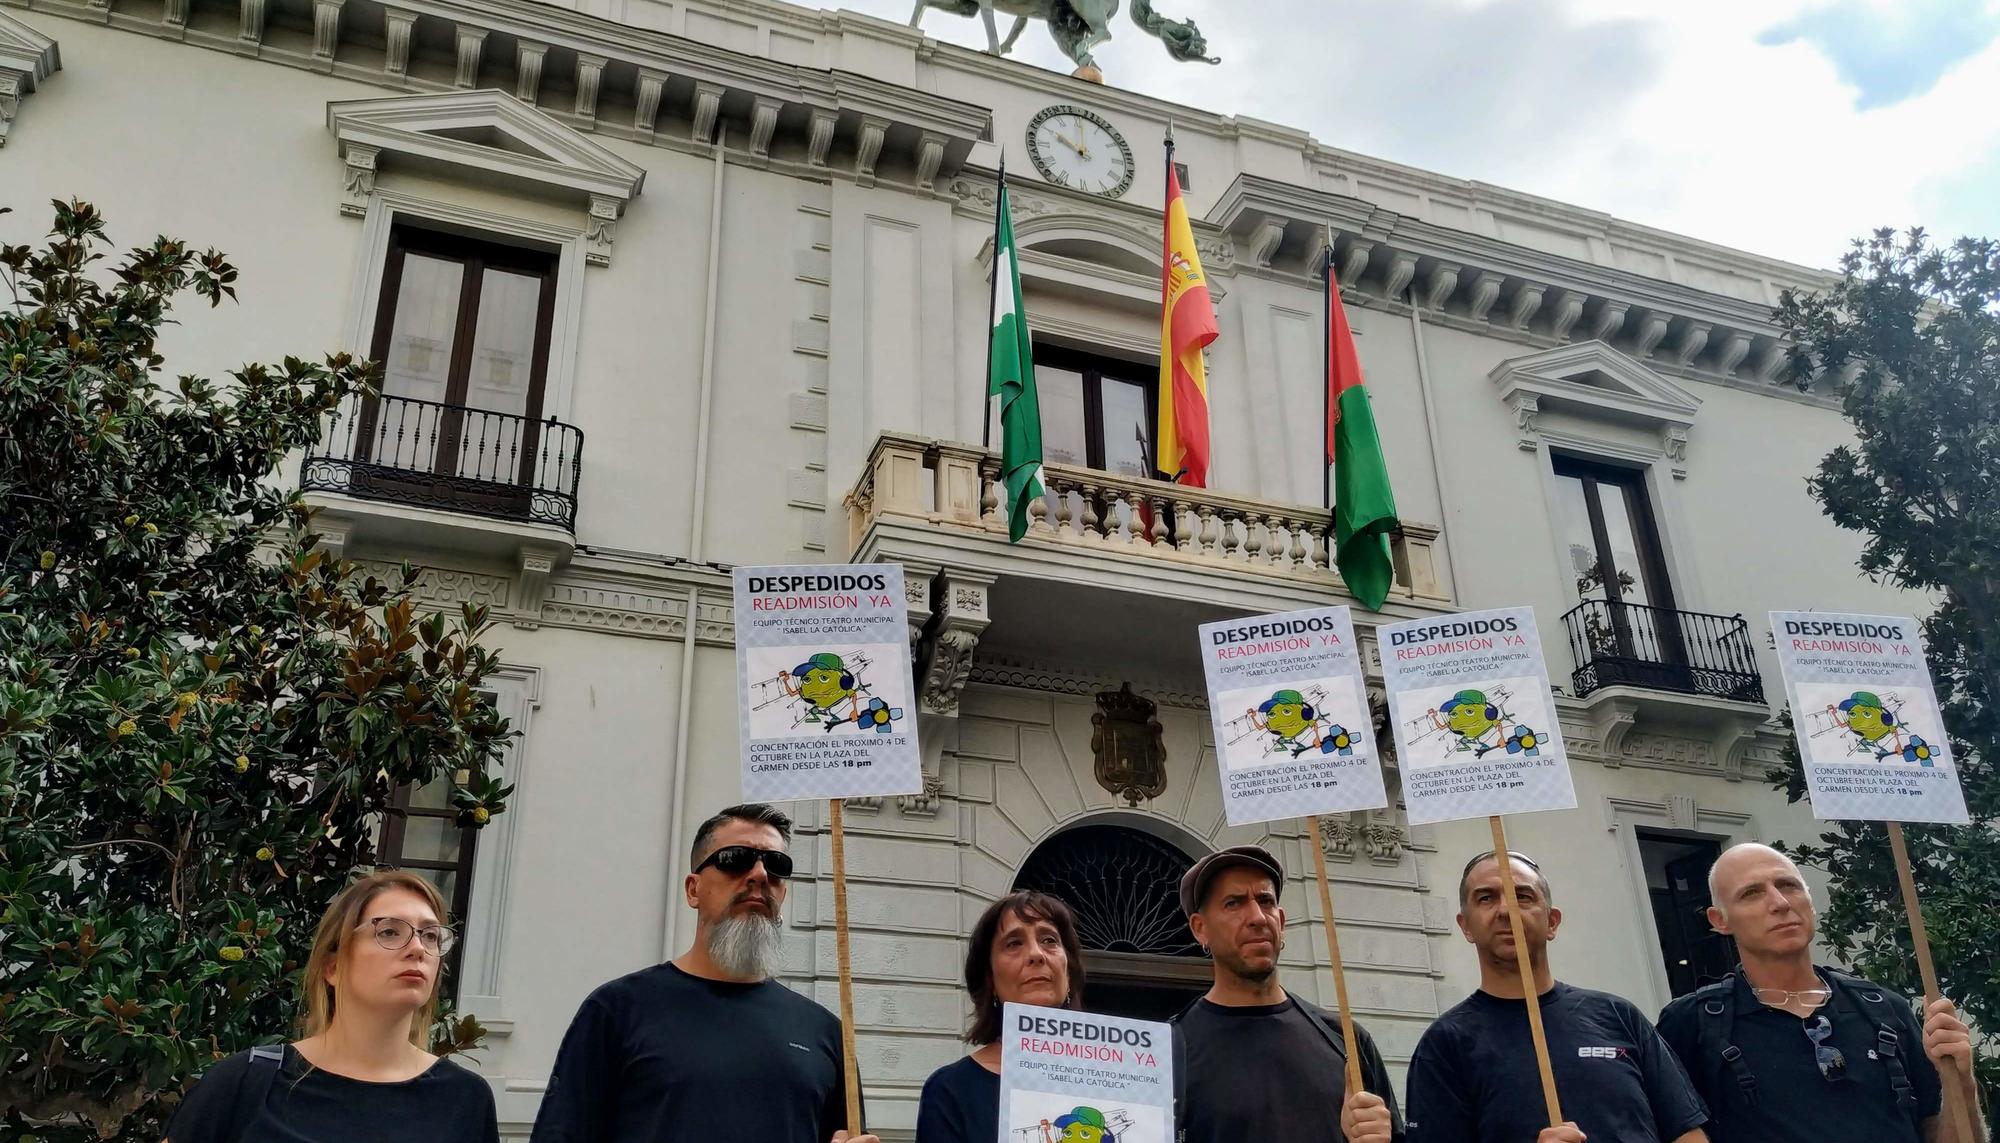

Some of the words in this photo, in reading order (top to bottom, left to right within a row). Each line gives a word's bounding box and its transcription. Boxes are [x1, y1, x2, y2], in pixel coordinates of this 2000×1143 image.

[749, 575, 885, 592] DESPEDIDOS
[754, 594, 858, 610] READMISIÓN
[869, 595, 891, 607] YA
[783, 626, 808, 634] ISABEL
[1213, 617, 1333, 645] DESPEDIDOS
[1391, 618, 1517, 646] DESPEDIDOS
[1785, 621, 1903, 640] DESPEDIDOS
[1218, 636, 1310, 660] READMISIÓN
[1320, 634, 1341, 646] YA
[1397, 637, 1493, 661] READMISIÓN
[1503, 635, 1525, 647] YA
[1792, 639, 1883, 654] READMISIÓN
[1890, 645, 1911, 655] YA
[1220, 665, 1245, 673] EQUIPO
[1247, 661, 1277, 670] TÉCNICO
[1308, 653, 1346, 662] MUNICIPAL
[1246, 669, 1268, 677] ISABEL
[1281, 664, 1316, 672] CATÓLICA
[1400, 666, 1425, 674] EQUIPO
[1428, 661, 1459, 669] TÉCNICO
[1461, 657, 1489, 665] TEATRO
[1492, 654, 1531, 662] MUNICIPAL
[1463, 664, 1499, 672] CATÓLICA
[1882, 662, 1917, 670] MUNICIPAL
[751, 741, 828, 752] CONCENTRACIÓN
[844, 739, 883, 747] PROXIMO
[751, 753, 792, 762] OCTUBRE
[751, 764, 789, 772] CARMEN
[792, 762, 820, 770] DESDE
[857, 760, 871, 768] pm
[1229, 767, 1296, 780] CONCENTRACIÓN
[1311, 761, 1346, 771] PROXIMO
[1410, 766, 1481, 780] CONCENTRACIÓN
[1496, 761, 1533, 770] PROXIMO
[1815, 768, 1882, 776] CONCENTRACIÓN
[1231, 779, 1266, 789] OCTUBRE
[1293, 773, 1317, 781] PLAZA
[1412, 779, 1449, 789] OCTUBRE
[1477, 773, 1503, 781] PLAZA
[1232, 789, 1264, 798] CARMEN
[1267, 785, 1291, 793] DESDE
[1324, 781, 1337, 789] pm
[1413, 789, 1447, 798] CARMEN
[1019, 1016, 1151, 1047] DESPEDIDOS
[1021, 1038, 1123, 1063] READMISIÓN
[1135, 1052, 1156, 1067] YA
[1020, 1061, 1047, 1070] EQUIPO
[1051, 1064, 1083, 1074] TÉCNICO
[1086, 1069, 1116, 1078] TEATRO
[1119, 1074, 1159, 1084] MUNICIPAL
[1048, 1073, 1072, 1082] ISABEL
[1087, 1078, 1125, 1089] CATÓLICA
